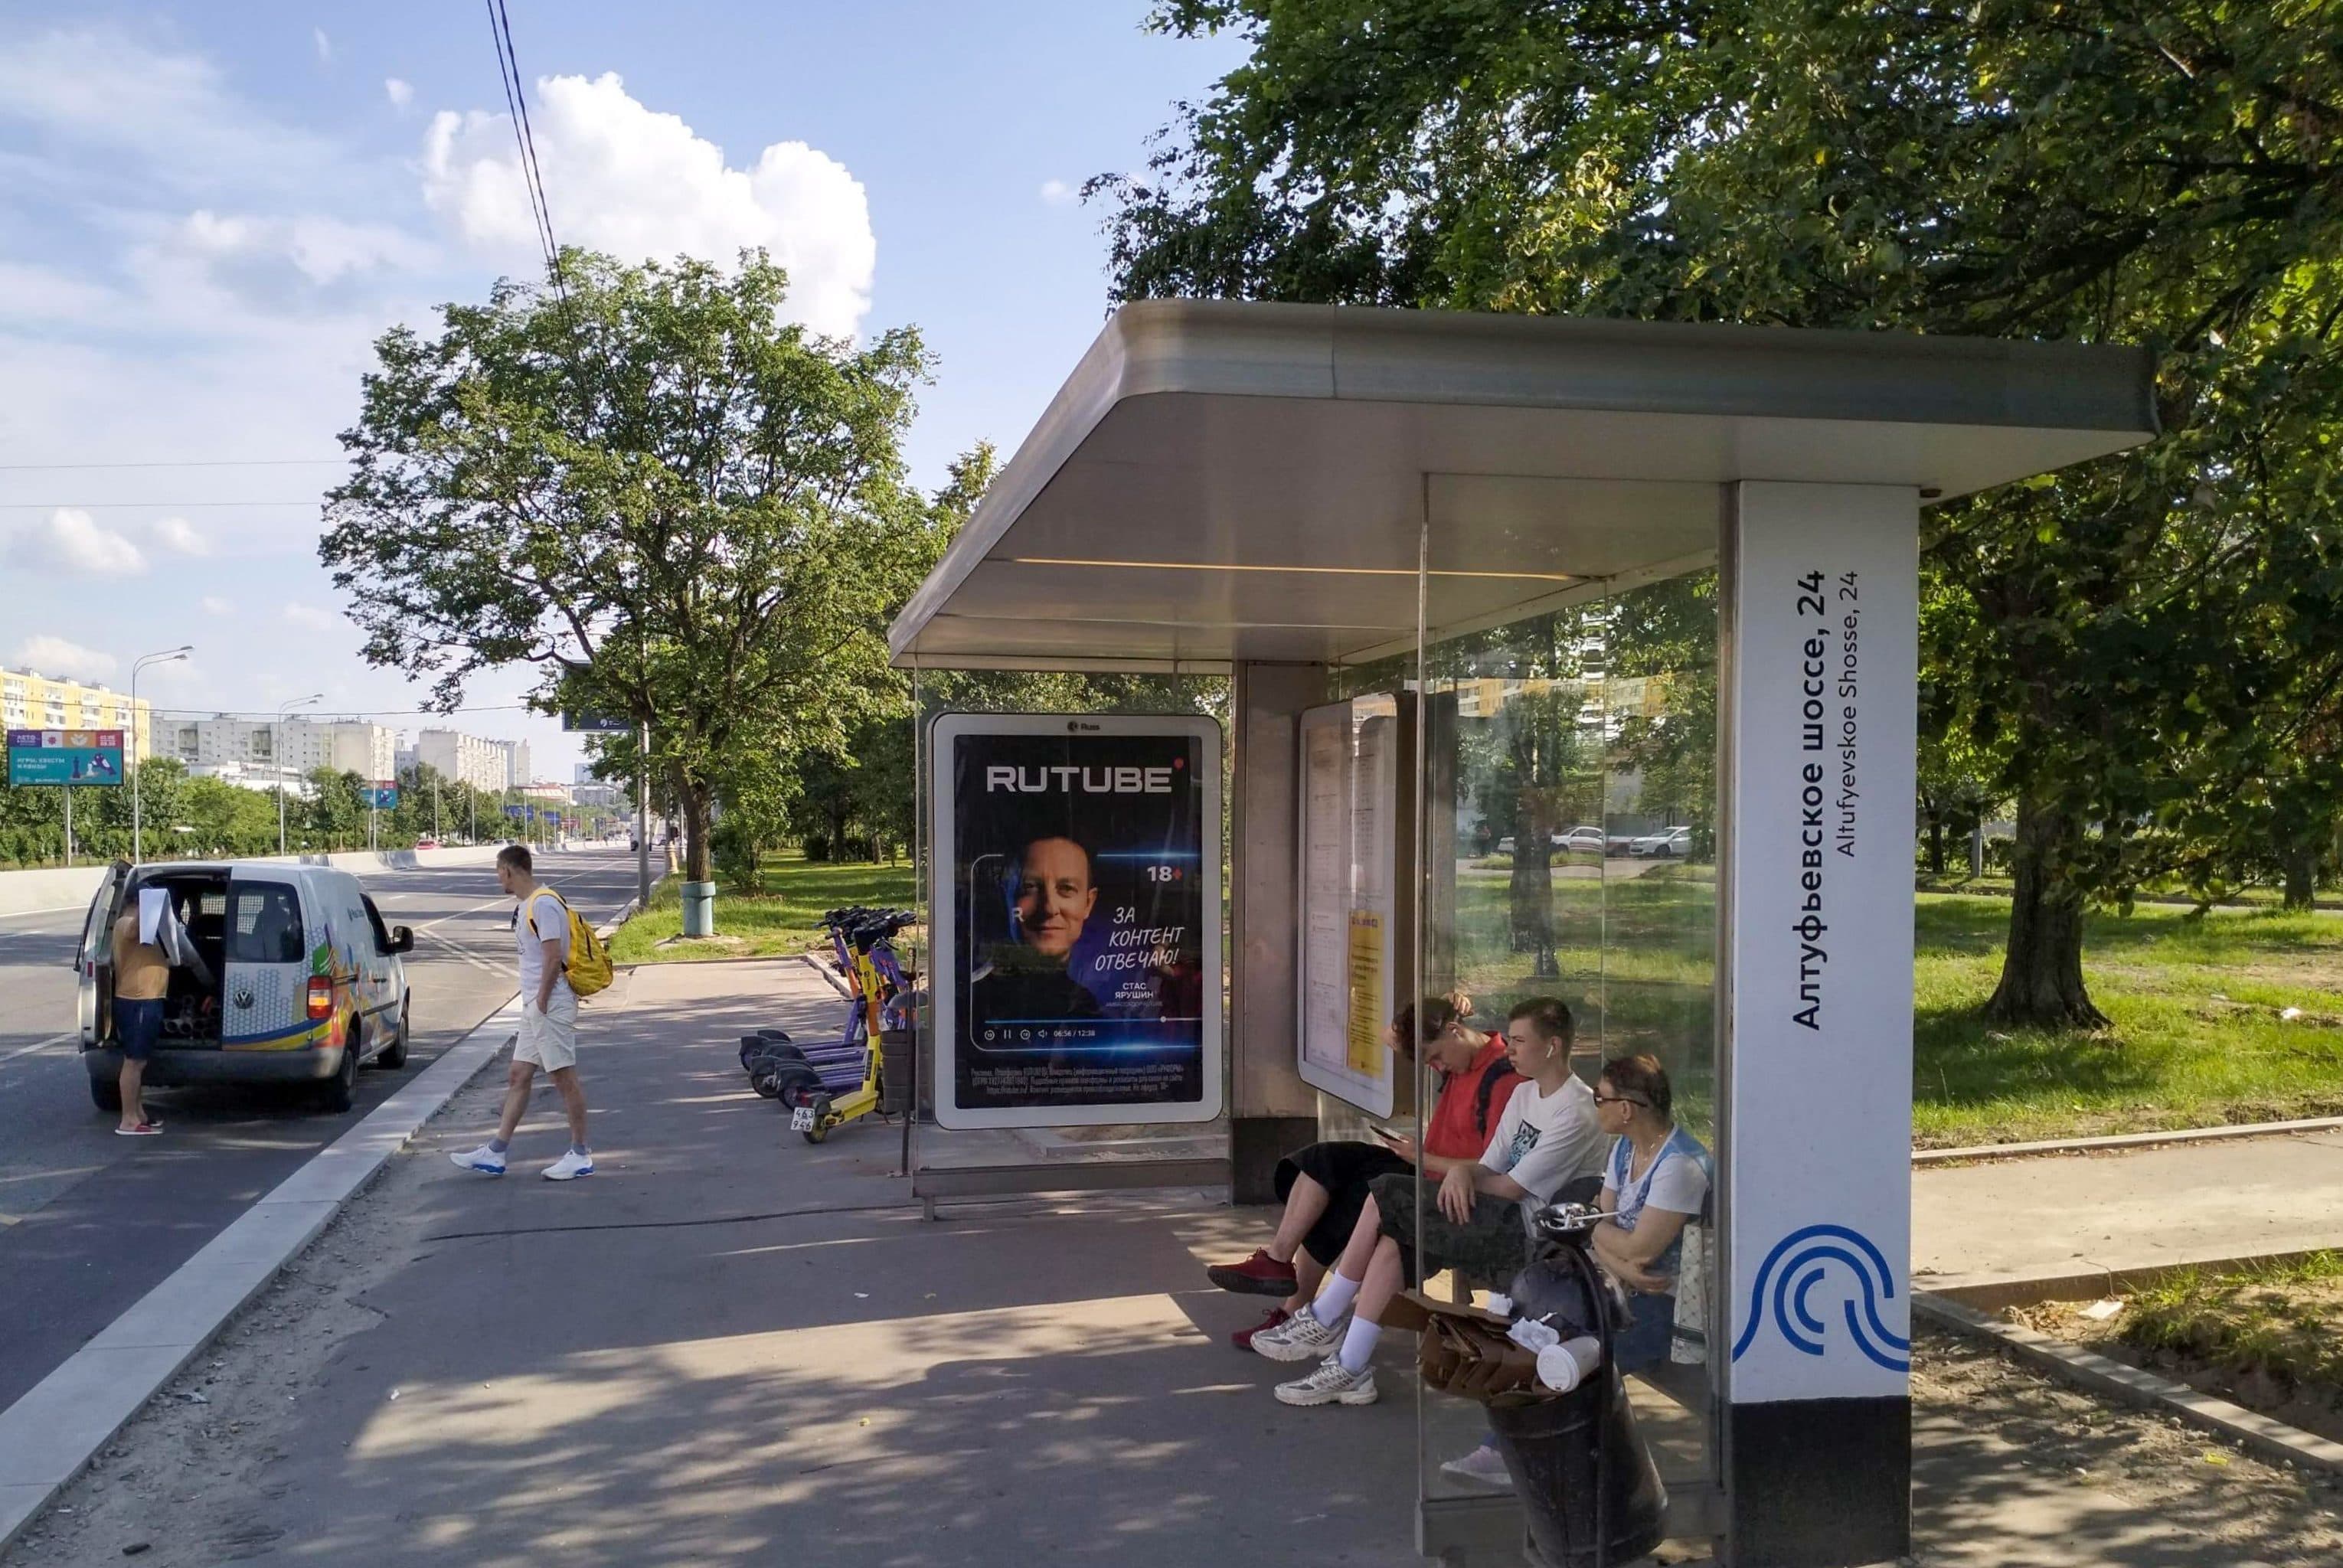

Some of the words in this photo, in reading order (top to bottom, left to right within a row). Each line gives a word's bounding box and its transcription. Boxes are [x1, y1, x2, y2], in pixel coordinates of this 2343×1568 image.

[1796, 570, 1825, 616] 24
[1839, 570, 1858, 602] 24
[1838, 609, 1861, 698] Shosse,
[1802, 628, 1831, 751] шоссе,
[986, 766, 1173, 793] RUTUBE
[1835, 705, 1860, 858] Altufyevskoe
[1792, 763, 1828, 1031] Алтуфьевское
[1113, 906, 1136, 925] ЗА
[1108, 926, 1185, 948] КОНТЕНТ
[1095, 948, 1180, 972] ОТВЕЧАЮ!
[1115, 991, 1155, 1000] ЯРУШИН
[1122, 982, 1147, 991] СТАС
[796, 1109, 815, 1119] 463
